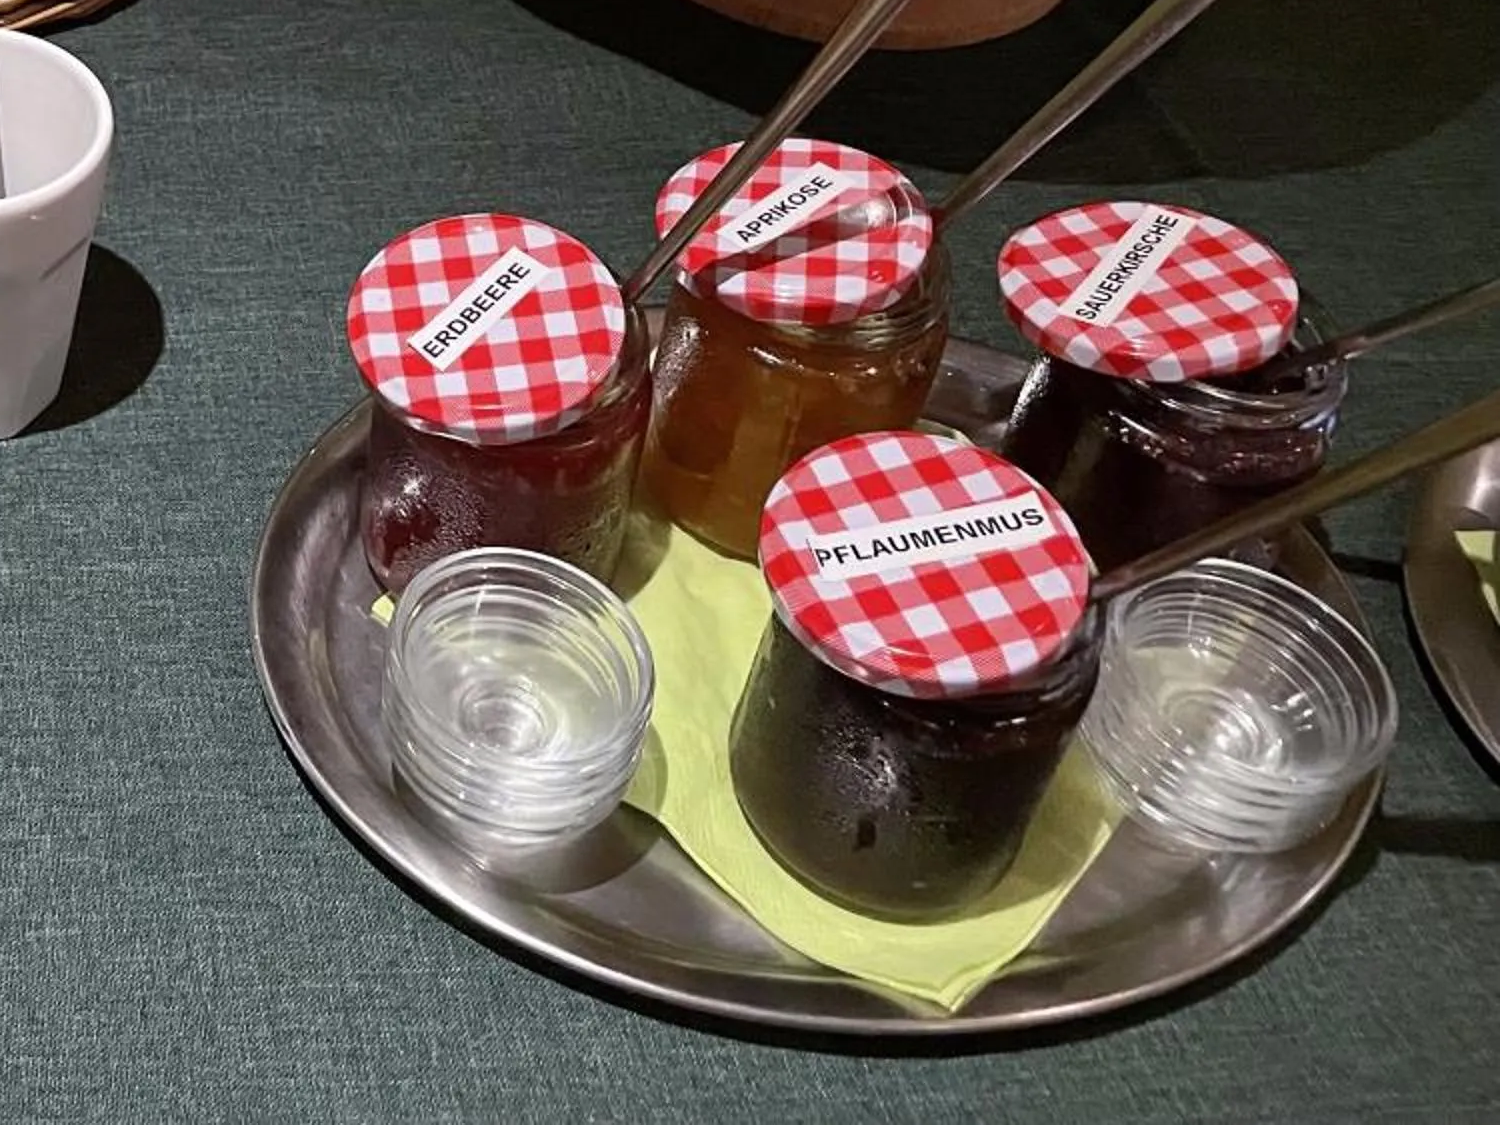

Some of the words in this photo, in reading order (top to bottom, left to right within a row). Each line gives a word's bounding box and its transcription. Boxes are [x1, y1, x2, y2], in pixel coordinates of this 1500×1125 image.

[736, 176, 834, 243] APRIKOSE
[1075, 214, 1179, 320] SAUERKIRSCHE
[422, 262, 531, 358] ERDBEERE
[815, 508, 1045, 567] PFLAUMENMUS
